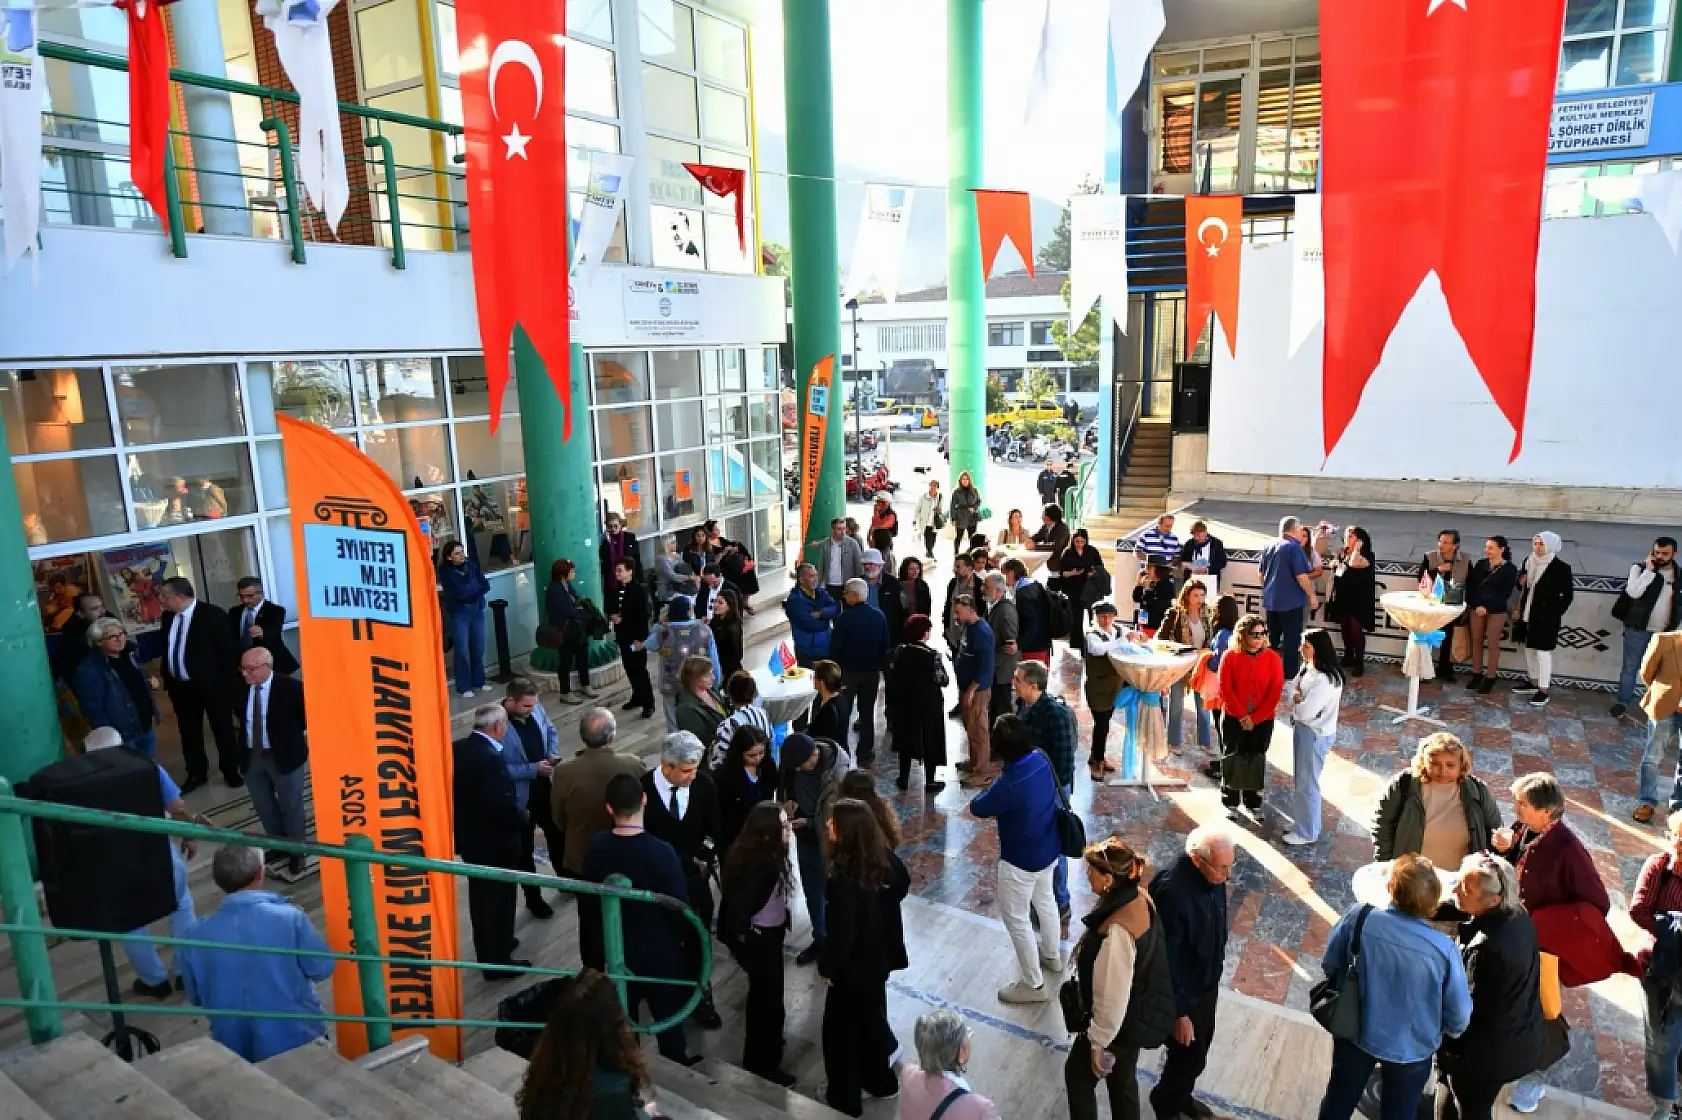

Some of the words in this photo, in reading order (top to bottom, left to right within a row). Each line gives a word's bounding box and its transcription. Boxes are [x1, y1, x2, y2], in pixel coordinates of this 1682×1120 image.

[1558, 102, 1593, 113] FETHİYE
[1596, 96, 1648, 109] BELEDİYESİ
[1600, 107, 1643, 118] MERKEZİ
[1606, 117, 1645, 133] DİRLİK
